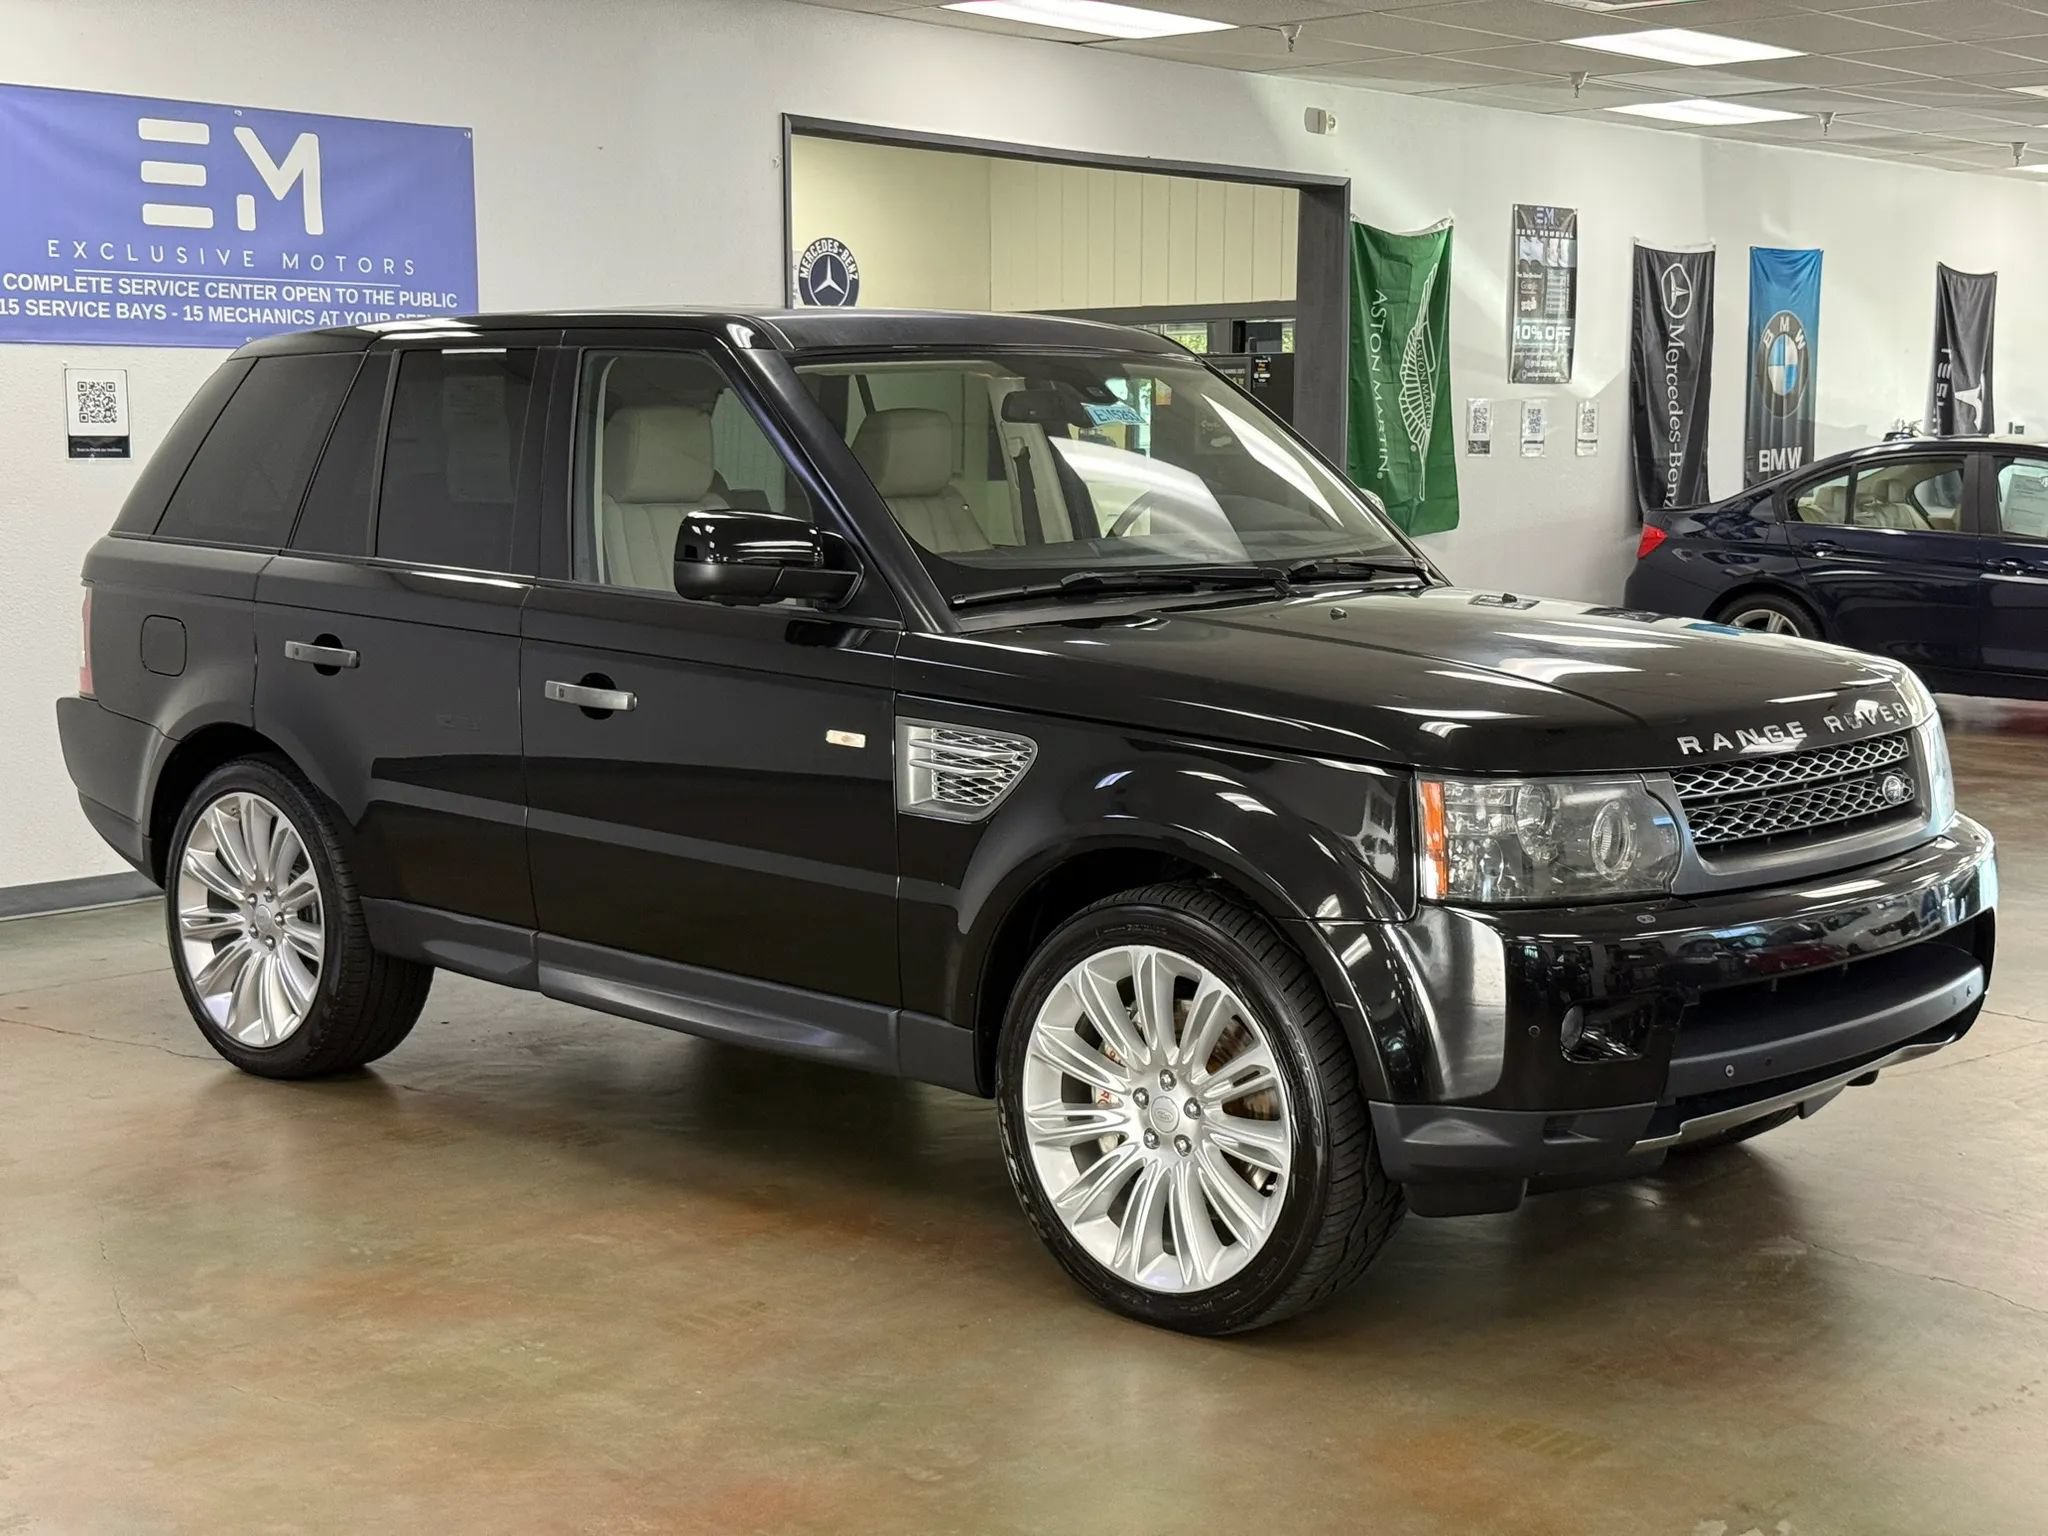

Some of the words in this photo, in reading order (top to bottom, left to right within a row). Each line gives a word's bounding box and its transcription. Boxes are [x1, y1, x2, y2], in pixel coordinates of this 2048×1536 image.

[138, 117, 324, 235] EM
[48, 239, 254, 268] EXCLUSIVE
[282, 253, 415, 275] MOTORS
[799, 239, 859, 280] MERCEDES-BENZ
[3, 272, 113, 294] COMPLETE
[118, 277, 200, 298] SERVICE
[205, 282, 278, 301] CENTER
[282, 286, 331, 303] OPEN
[335, 288, 358, 304] TO
[362, 289, 395, 306] THE
[400, 291, 458, 308] PUBLIC
[0, 298, 20, 315] 15
[25, 299, 110, 318] SERVICE
[116, 302, 167, 320] BAYS
[183, 305, 203, 321] 15
[208, 306, 315, 326] MECHANICS
[319, 310, 341, 326] AT
[1370, 289, 1388, 372] ASTON
[1763, 316, 1806, 350] BMW
[1415, 340, 1427, 381] ASTON
[1373, 380, 1390, 472] MARTIN
[1758, 446, 1802, 473] BMW
[1676, 721, 1808, 755] RANGE
[1823, 702, 1909, 734] ROVER
